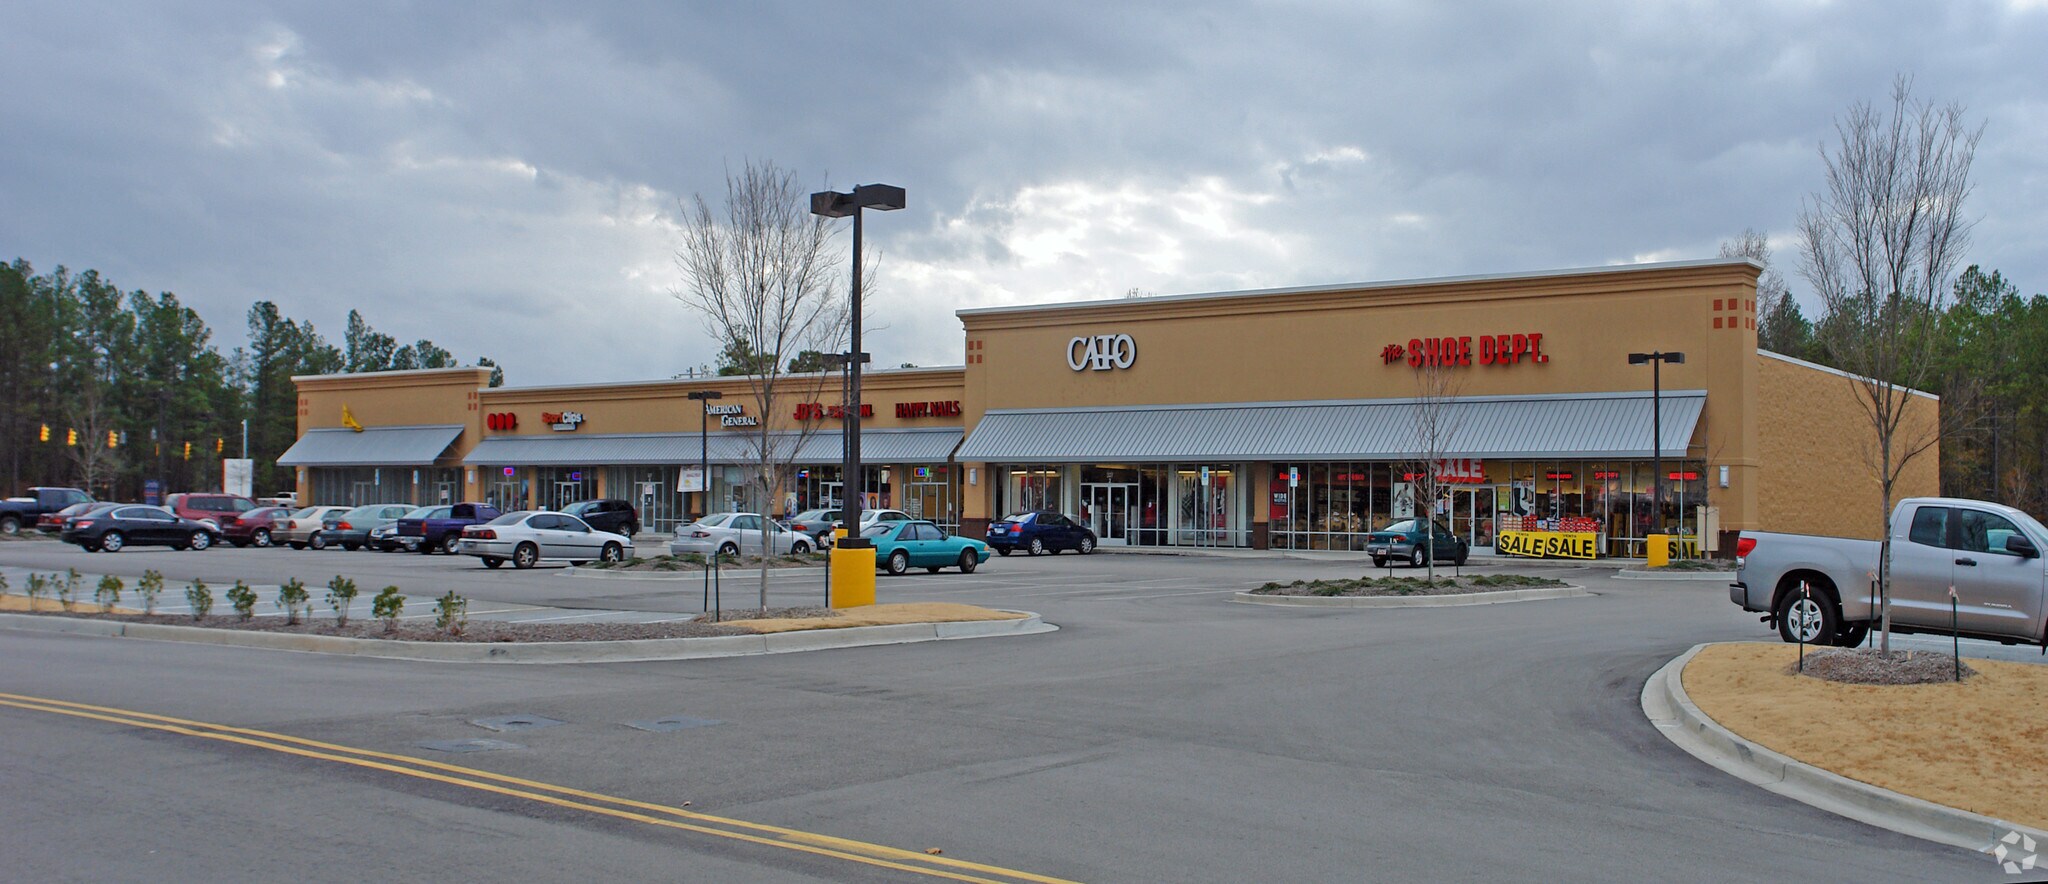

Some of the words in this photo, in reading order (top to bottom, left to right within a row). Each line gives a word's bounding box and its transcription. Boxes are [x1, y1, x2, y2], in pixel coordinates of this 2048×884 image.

[1067, 333, 1136, 371] CATO
[1408, 336, 1471, 368] SHOE
[1480, 333, 1549, 365] DEPT.
[705, 404, 743, 415] AMERICAN
[895, 402, 927, 418] HAPPY
[930, 400, 961, 417] NAILS
[721, 414, 756, 427] GENERAL
[1431, 459, 1483, 479] SALE
[1500, 535, 1544, 556] SALE
[1547, 537, 1593, 557] SALE
[1668, 541, 1700, 559] SAL
